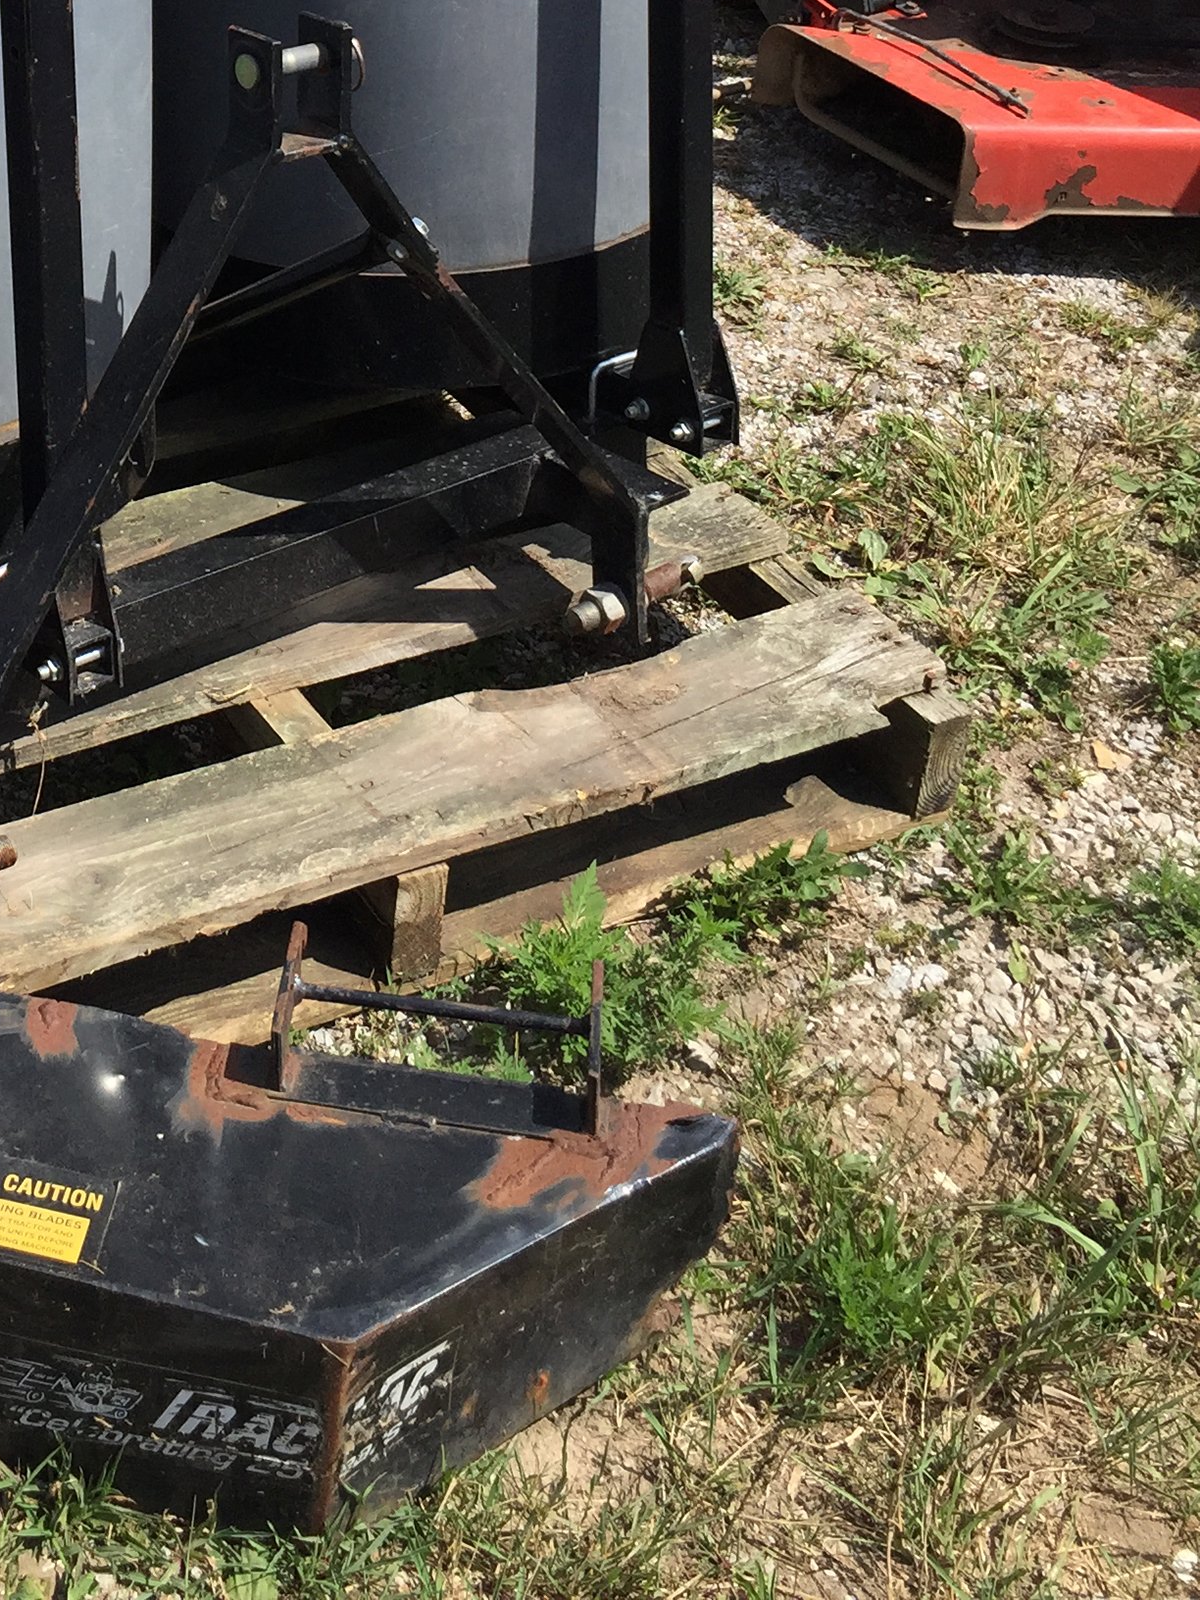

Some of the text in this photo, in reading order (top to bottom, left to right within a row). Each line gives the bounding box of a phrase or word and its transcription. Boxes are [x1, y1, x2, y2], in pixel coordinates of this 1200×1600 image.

[3, 1173, 104, 1212] CAUTION
[8, 1217, 51, 1234] TRACTOR
[53, 1227, 74, 1238] AND
[28, 1209, 83, 1230] BLADES
[8, 1226, 36, 1240] UNITS
[37, 1233, 75, 1248] BEFORE
[19, 1239, 65, 1256] MACHINE
[151, 1388, 323, 1455] TRAC
